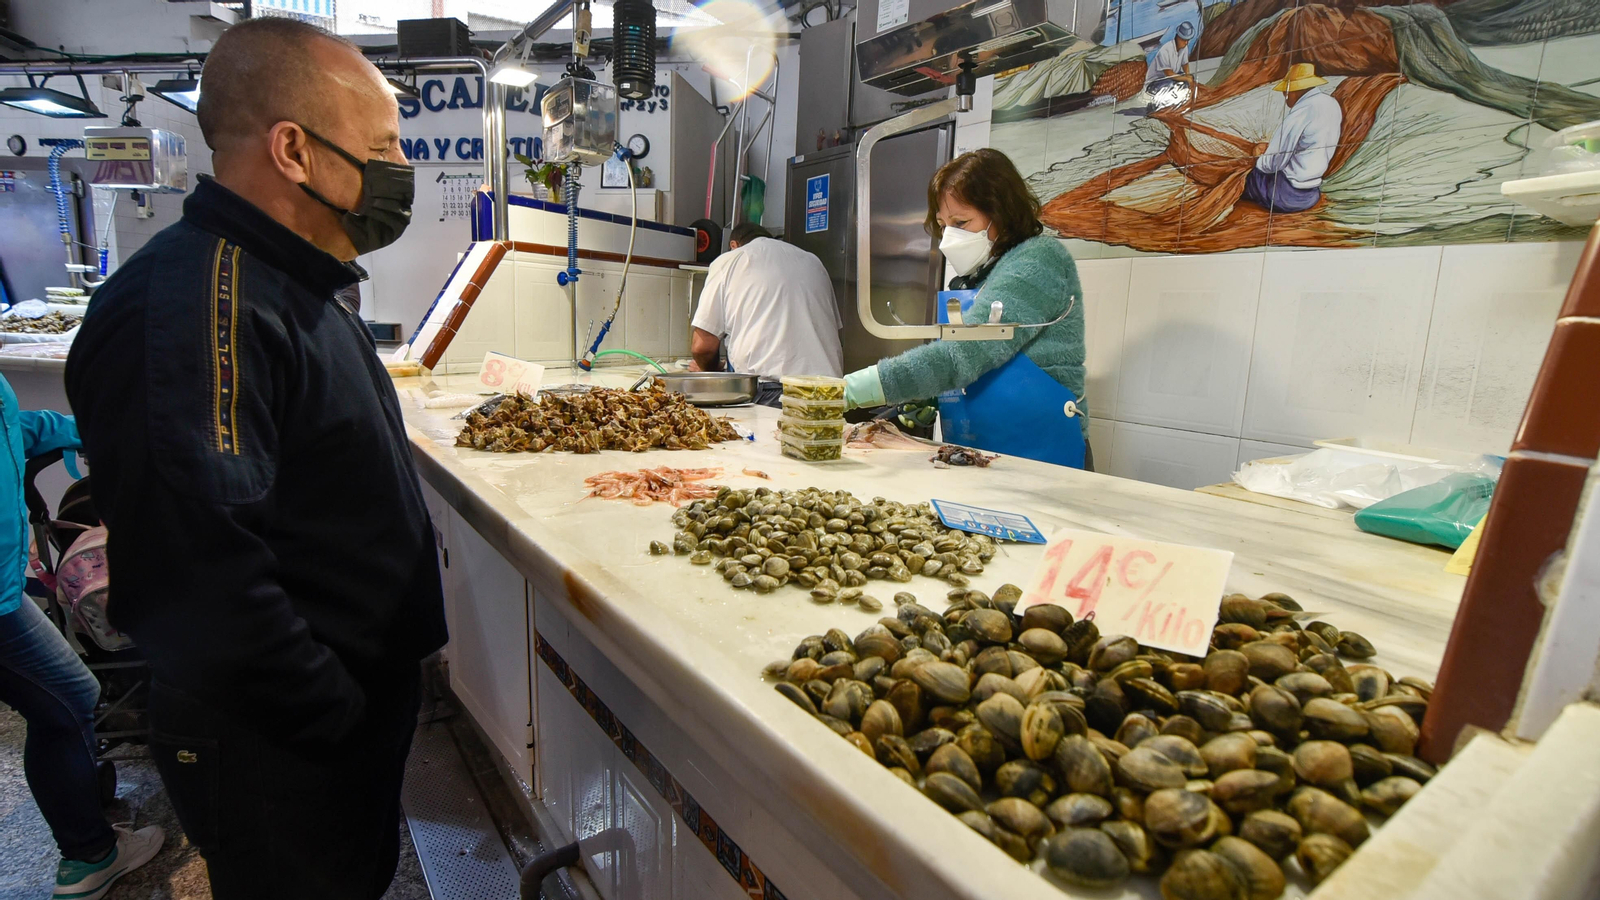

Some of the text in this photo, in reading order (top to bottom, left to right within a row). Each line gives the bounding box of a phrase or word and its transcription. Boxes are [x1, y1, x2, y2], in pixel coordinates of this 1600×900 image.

[636, 100, 646, 111] 2
[647, 101, 657, 114] y
[659, 98, 668, 111] 3
[434, 138, 450, 160] Y
[1136, 599, 1205, 647] Kilo
